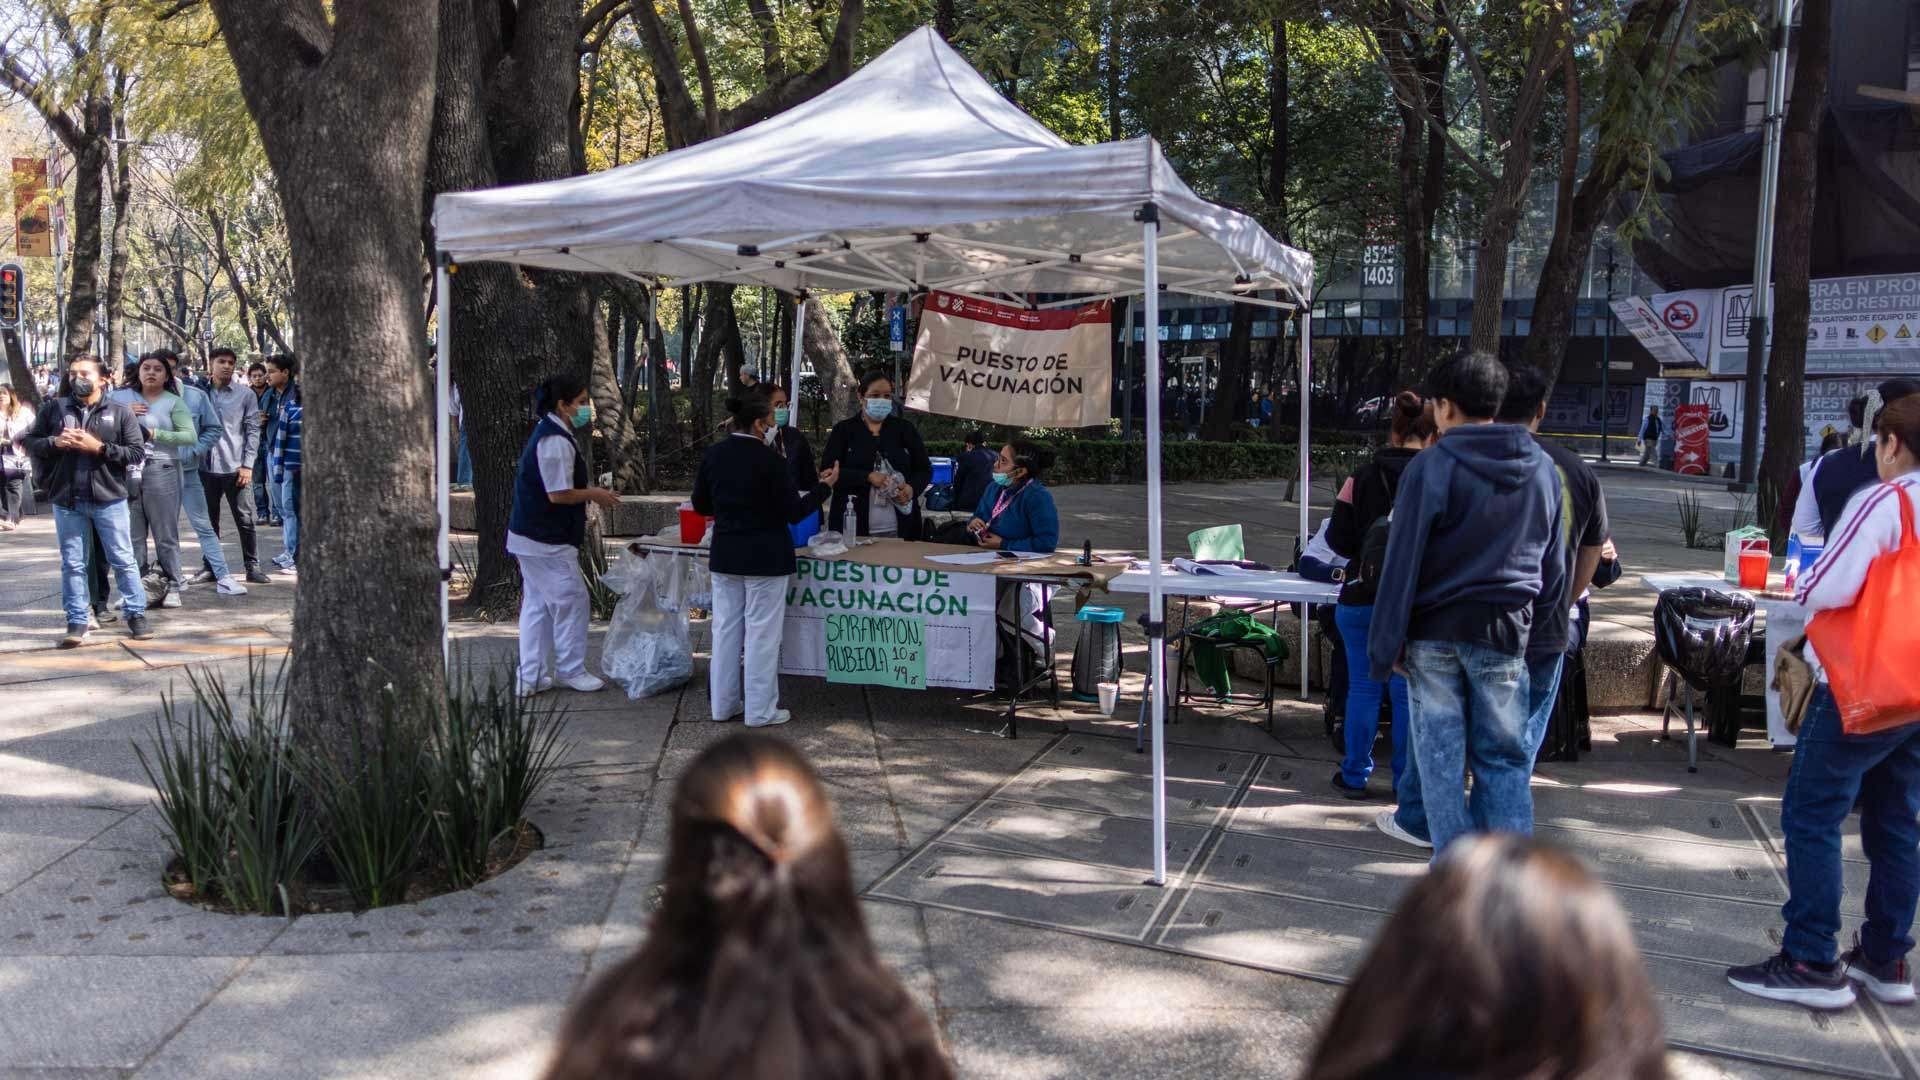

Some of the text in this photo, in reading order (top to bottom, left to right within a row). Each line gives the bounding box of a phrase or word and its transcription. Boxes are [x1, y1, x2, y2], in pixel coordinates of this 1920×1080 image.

[1363, 266, 1394, 285] 1403
[1846, 281, 1870, 295] EN
[1876, 277, 1920, 293] PRO
[1810, 297, 1853, 311] CESO
[957, 346, 1068, 372] PUESTO DE
[940, 365, 1083, 394] VACUNACIÓN
[797, 559, 950, 587] PUESTO DE
[785, 586, 968, 616] VACUNACIÓN
[892, 646, 908, 660] 10
[894, 665, 908, 684] 49
